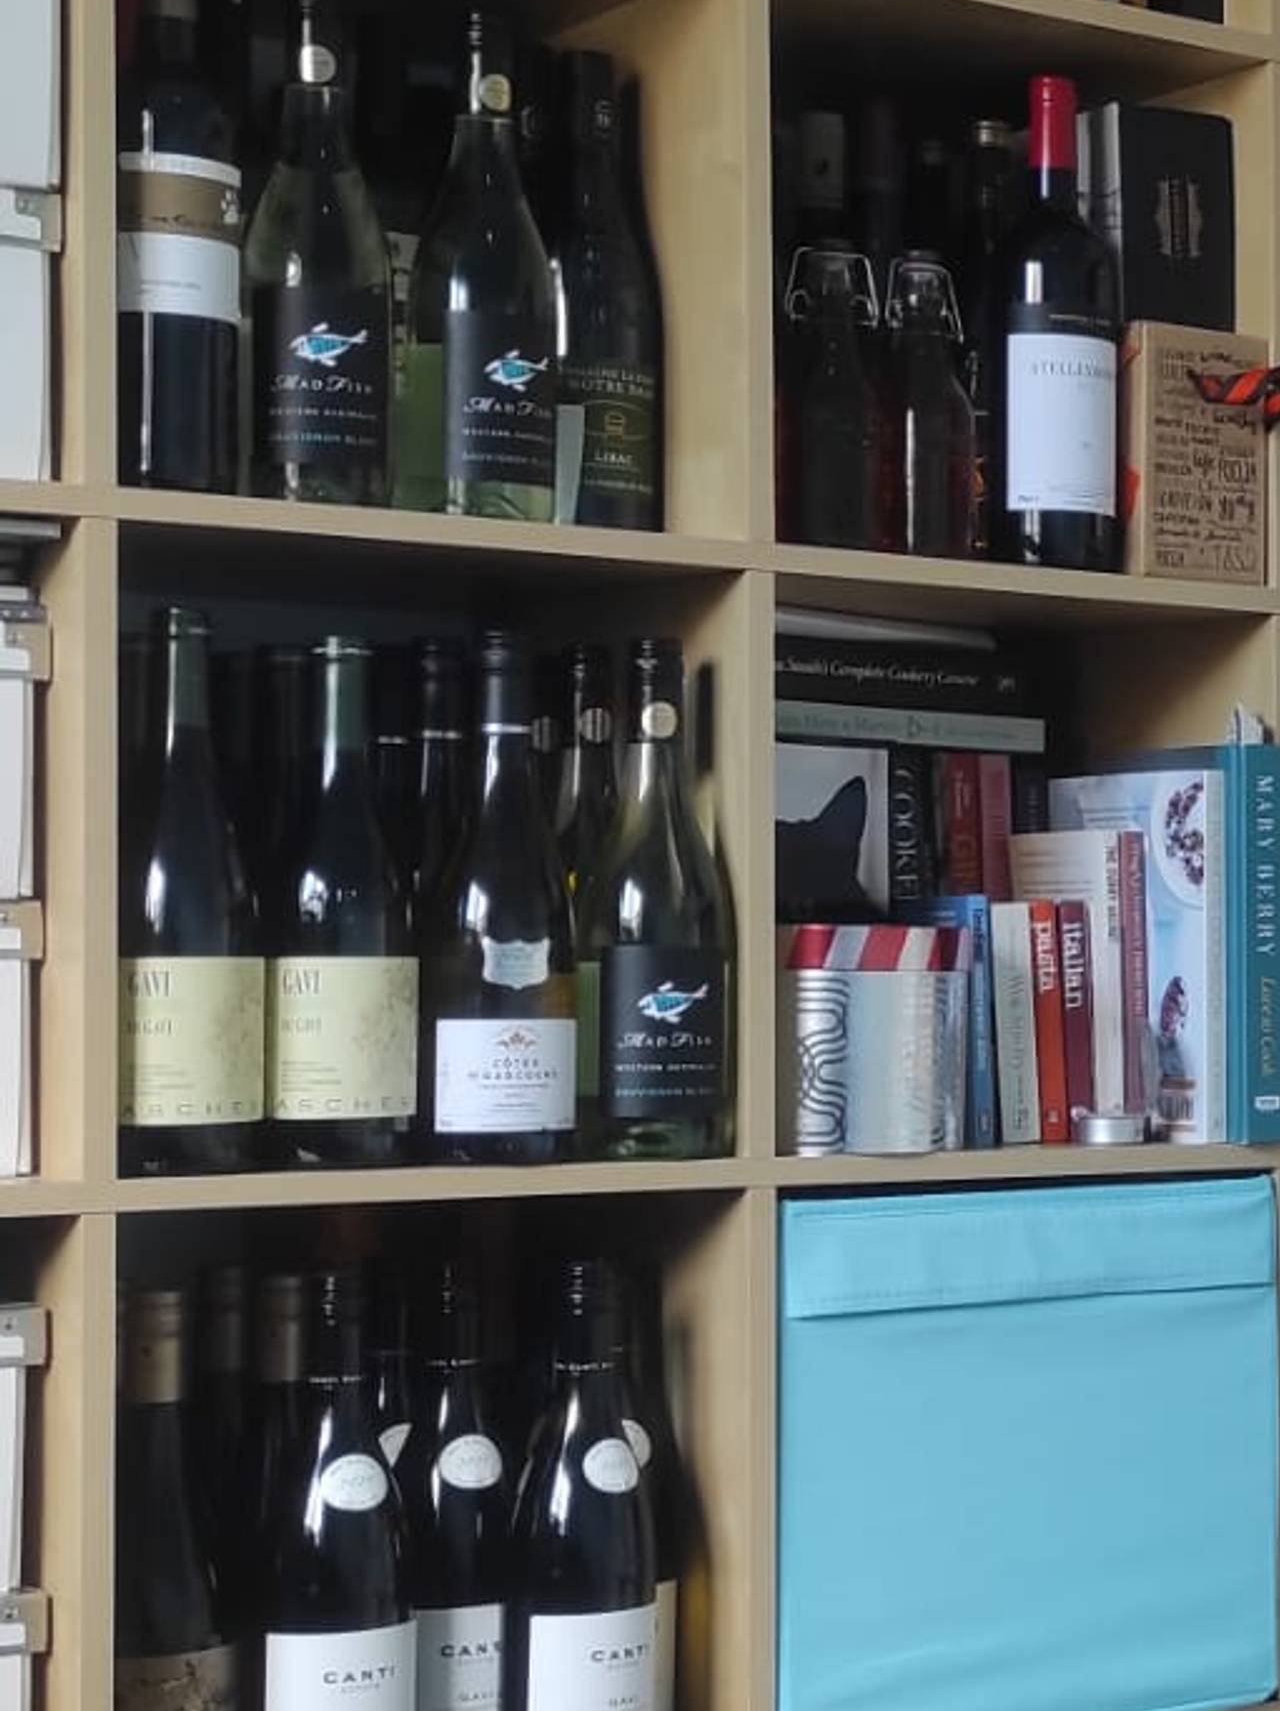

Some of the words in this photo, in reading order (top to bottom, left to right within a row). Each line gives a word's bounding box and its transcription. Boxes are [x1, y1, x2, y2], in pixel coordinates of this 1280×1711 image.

[1254, 774, 1277, 849] MARY
[1255, 864, 1277, 957] BERRY
[1034, 921, 1057, 994] pasta
[322, 1664, 397, 1685] CANTI
